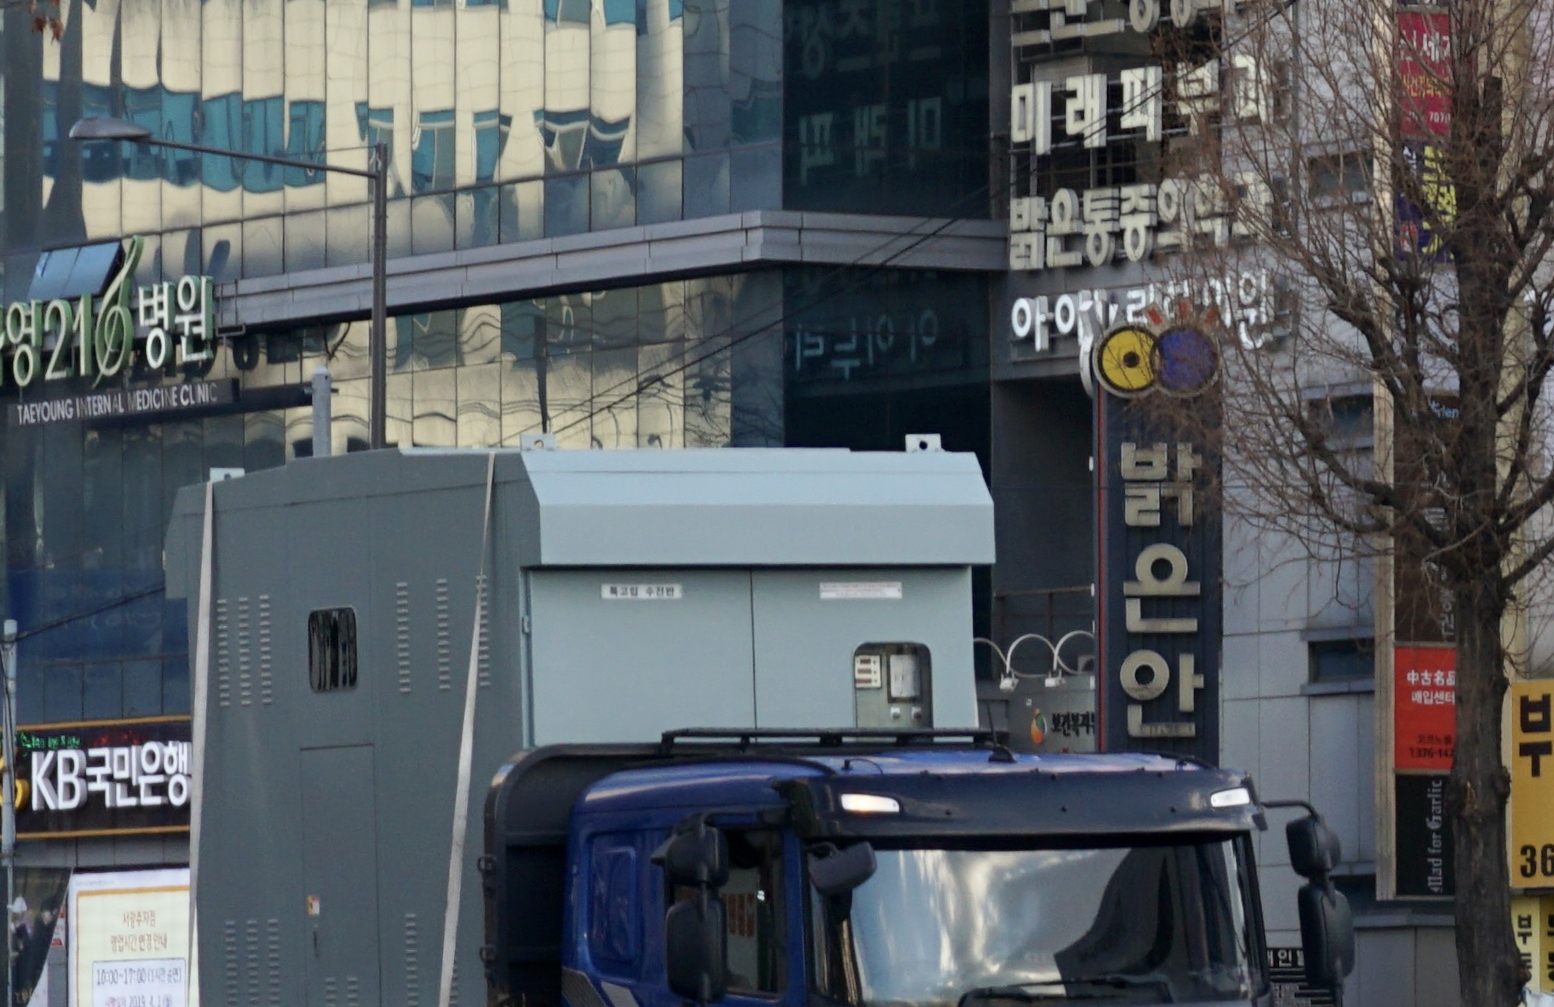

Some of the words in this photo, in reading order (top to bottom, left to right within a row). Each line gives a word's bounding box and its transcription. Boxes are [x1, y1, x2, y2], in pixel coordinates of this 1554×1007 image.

[0, 236, 219, 389] 영216병원
[17, 401, 74, 426] TAEYOUNG
[1119, 441, 1204, 739] 밝은안
[30, 740, 191, 811] KB국민은행
[1425, 779, 1443, 830] Garlic
